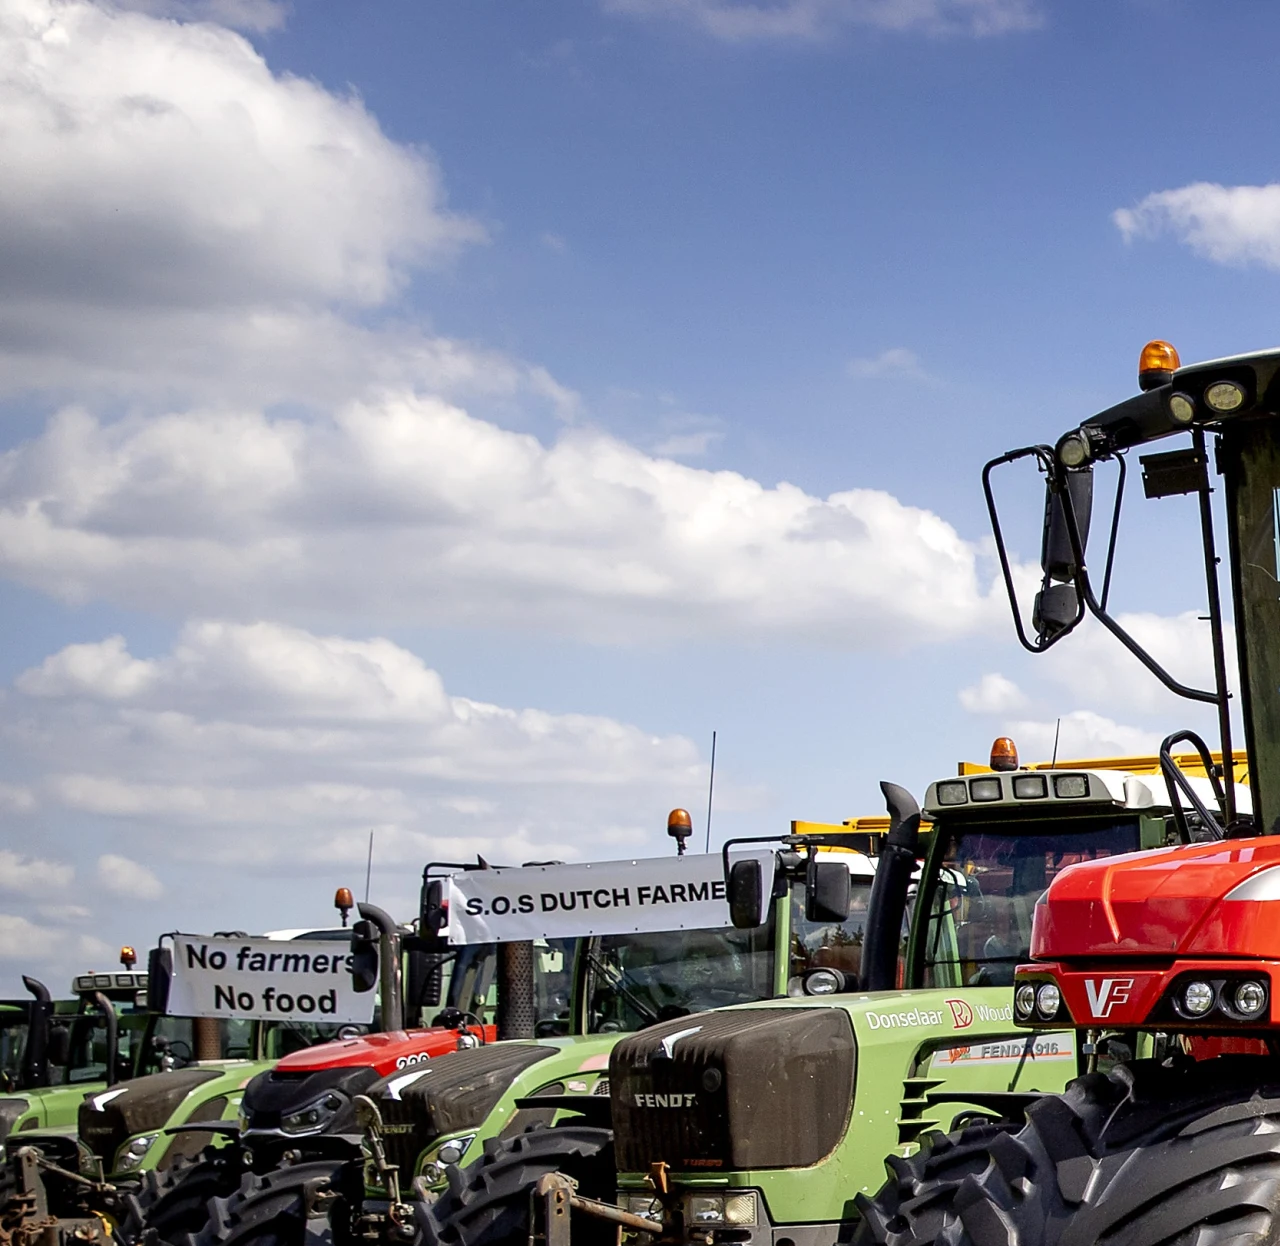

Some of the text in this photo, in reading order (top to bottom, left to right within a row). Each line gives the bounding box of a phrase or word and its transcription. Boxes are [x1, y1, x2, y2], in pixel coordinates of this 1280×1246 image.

[465, 894, 535, 916] S.O.S
[541, 888, 631, 912] DUTCH
[186, 944, 354, 974] No farmers
[214, 985, 336, 1014] No food
[1084, 978, 1135, 1018] VF
[865, 1007, 944, 1030] Donselaar
[1035, 1042, 1059, 1056] 916
[635, 1093, 696, 1108] FENDT
